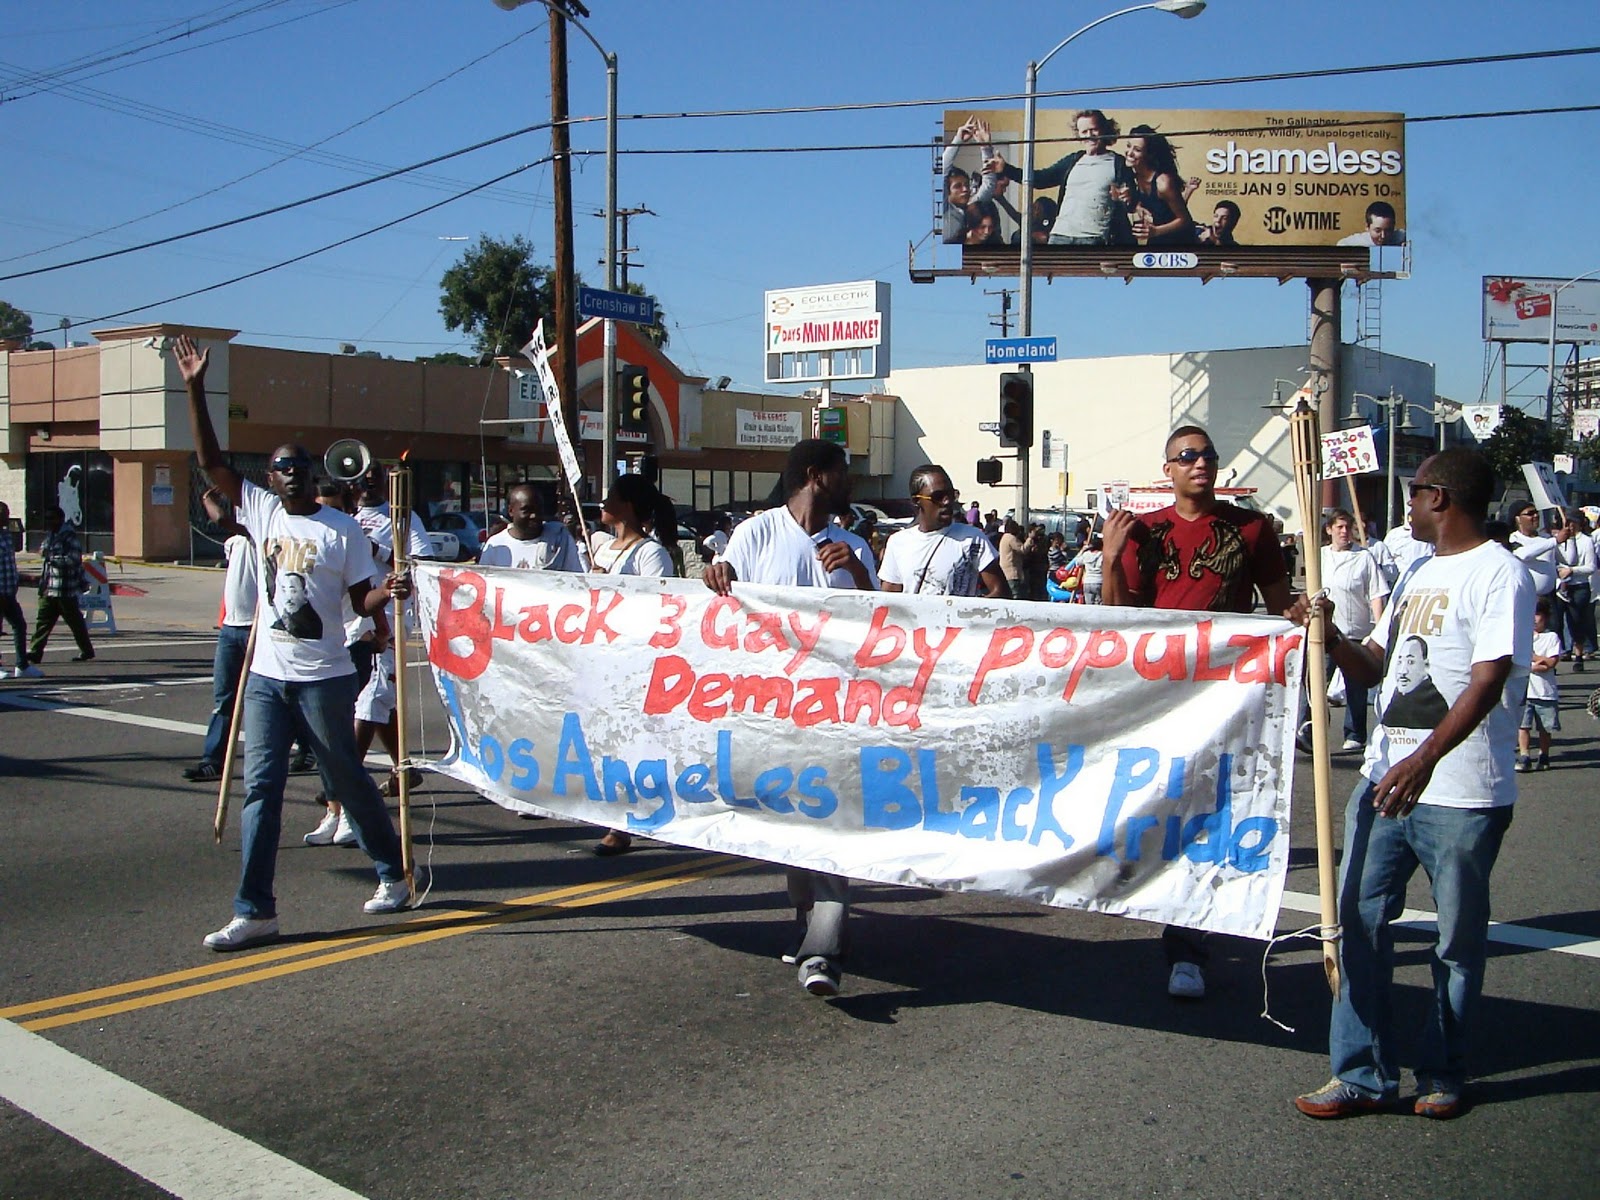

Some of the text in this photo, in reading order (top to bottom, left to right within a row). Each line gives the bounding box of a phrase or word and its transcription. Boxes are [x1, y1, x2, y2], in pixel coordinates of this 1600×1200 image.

[1265, 117, 1284, 125] The
[1269, 129, 1303, 138] Wildly,
[1205, 141, 1402, 174] shameless
[1239, 183, 1272, 196] JAN
[1276, 183, 1286, 196] 9
[1294, 183, 1369, 196] SUNDAYS
[1263, 206, 1341, 234] SHOWTIME
[1158, 253, 1189, 267] CBS
[584, 294, 636, 315] Crenshaw
[801, 290, 869, 305] ECKLECTIK
[772, 319, 879, 344] 7 DAYS MINI MARKET
[986, 342, 1056, 359] Homeland
[521, 382, 545, 401] E.B.
[700, 595, 832, 675] Gay
[854, 606, 964, 702] by
[643, 655, 924, 730] Demand
[440, 676, 540, 792] Los
